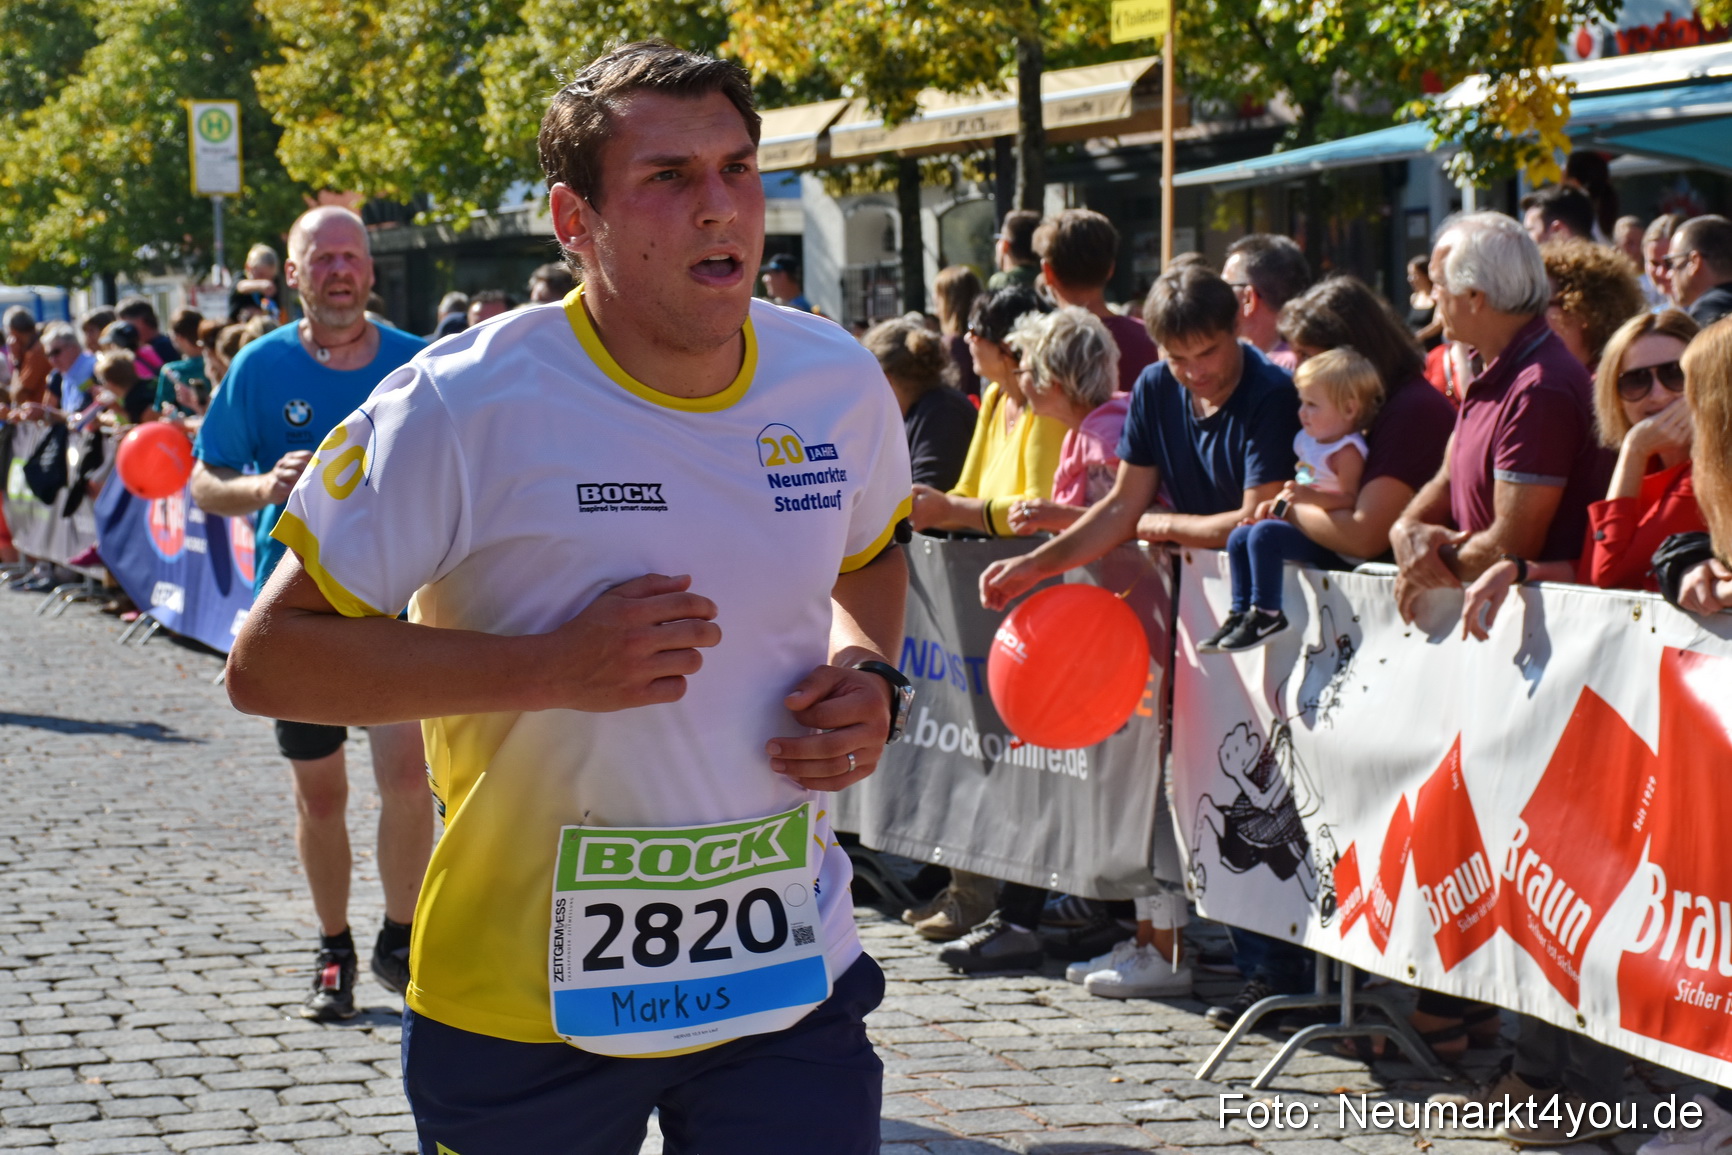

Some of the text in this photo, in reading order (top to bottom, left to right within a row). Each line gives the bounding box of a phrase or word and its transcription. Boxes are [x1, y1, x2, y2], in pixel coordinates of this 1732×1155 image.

[761, 435, 804, 467] 20
[577, 483, 666, 505] BOCK
[767, 467, 847, 489] Neumarkter
[774, 490, 842, 512] Stadtlauf
[575, 816, 792, 882] BOCK
[1418, 851, 1492, 937] Braun
[1500, 816, 1592, 956] Braun
[583, 888, 788, 972] 2820
[611, 984, 731, 1027] Markus
[1674, 978, 1723, 1011] Sicher
